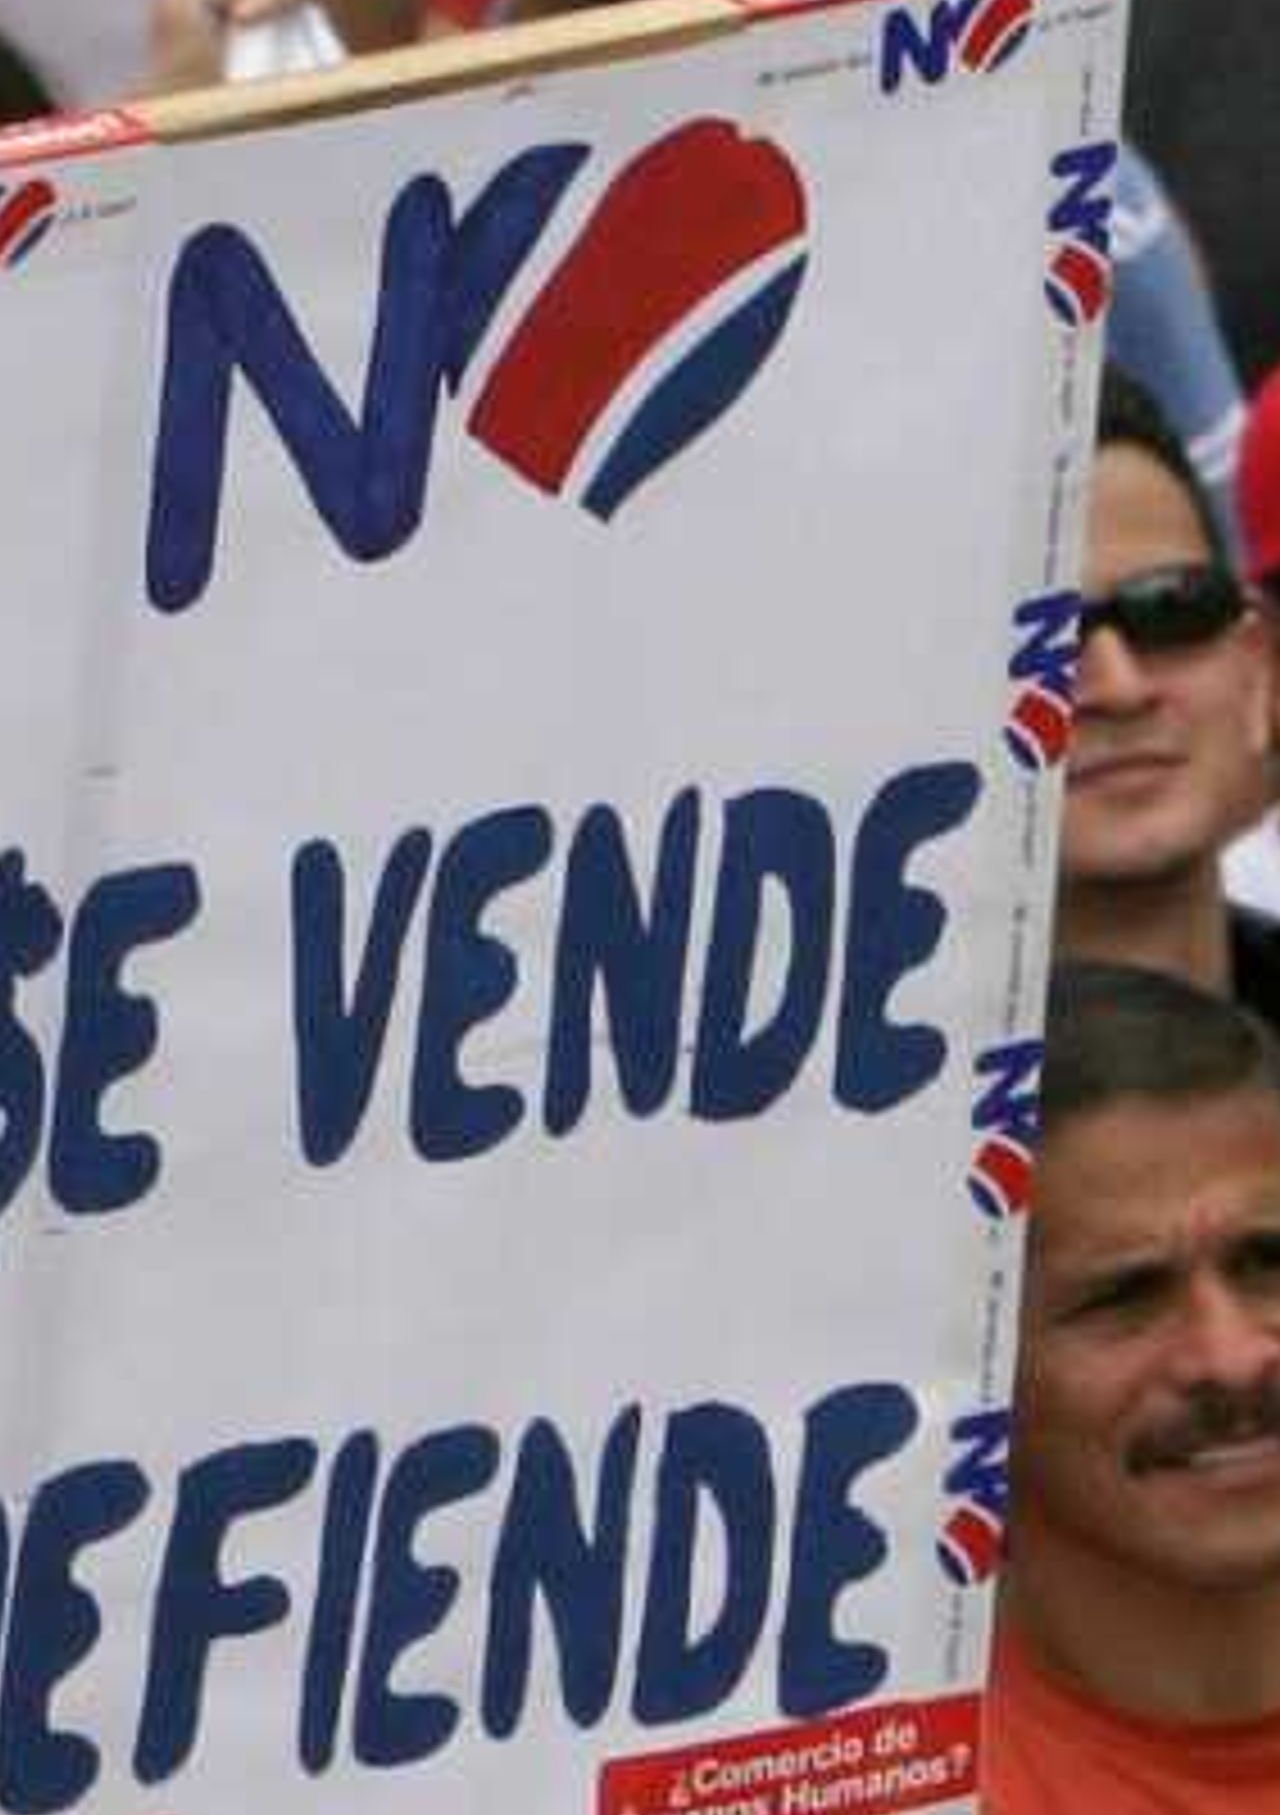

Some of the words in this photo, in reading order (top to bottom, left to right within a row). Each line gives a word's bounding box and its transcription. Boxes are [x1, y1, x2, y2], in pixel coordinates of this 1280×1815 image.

[147, 117, 808, 614] NO
[291, 761, 982, 1167] VENDE
[669, 1729, 864, 1807] ¿Comercio
[874, 1718, 919, 1755] de
